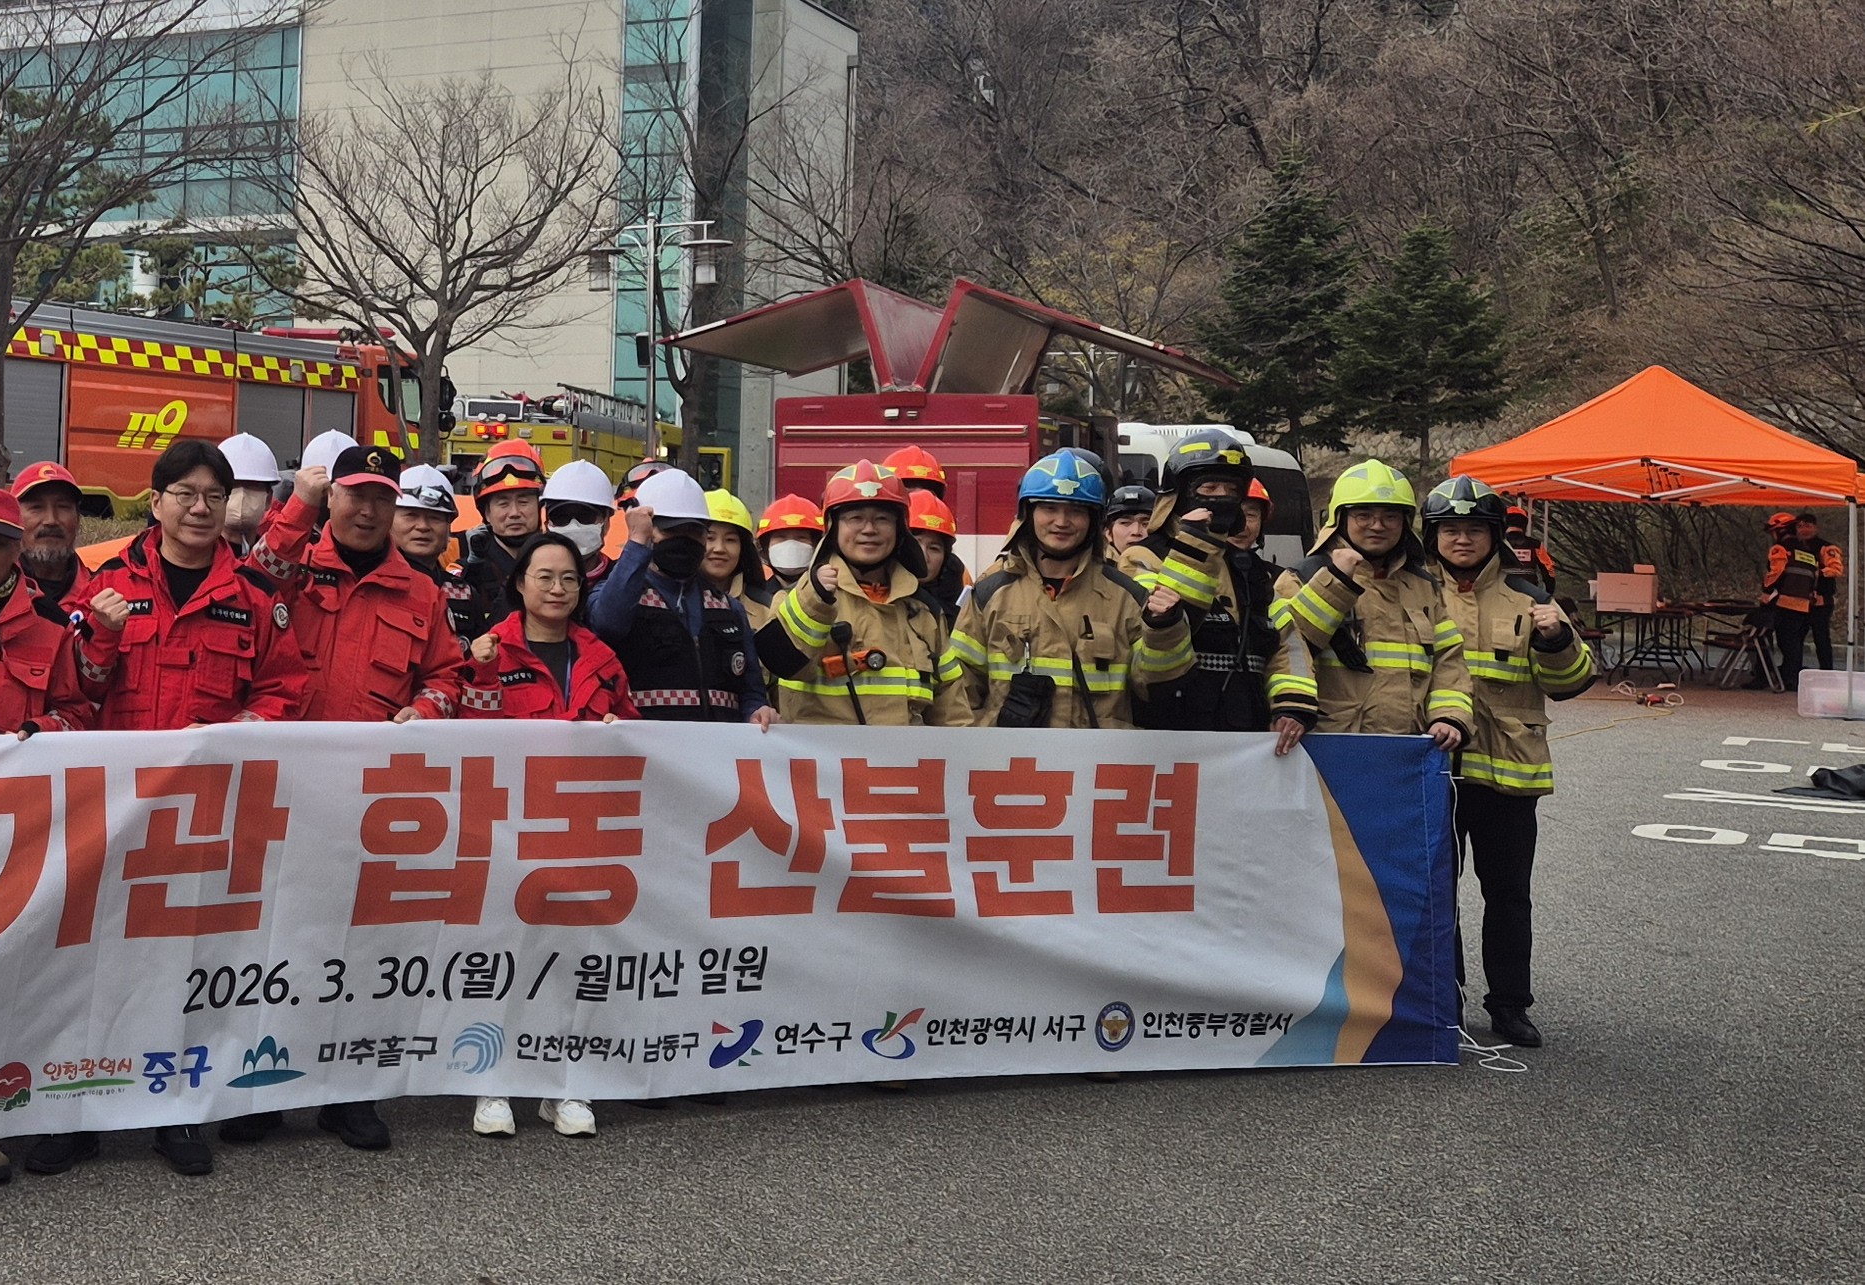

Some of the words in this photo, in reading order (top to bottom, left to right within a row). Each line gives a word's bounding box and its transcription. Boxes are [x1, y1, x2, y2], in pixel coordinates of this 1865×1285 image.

[116, 400, 188, 450] 119
[351, 752, 649, 927] 합동
[704, 757, 1200, 919] 산불훈련
[182, 958, 302, 1015] 2026.
[317, 958, 354, 1004] 3.
[371, 950, 515, 1003] 30.(월)
[572, 949, 685, 1003] 월미산
[697, 944, 768, 996] 일원
[774, 1022, 853, 1055] 연수구
[925, 1016, 1035, 1046] 인천광역시
[1043, 1015, 1087, 1044] 서구
[1142, 1011, 1293, 1041] 인천중부경찰서
[317, 1036, 438, 1068] 미추홀구
[516, 1032, 635, 1064] 인천광역시
[643, 1031, 701, 1062] 남동구
[43, 1057, 133, 1082] 인천광역시
[141, 1045, 213, 1095] 중구
